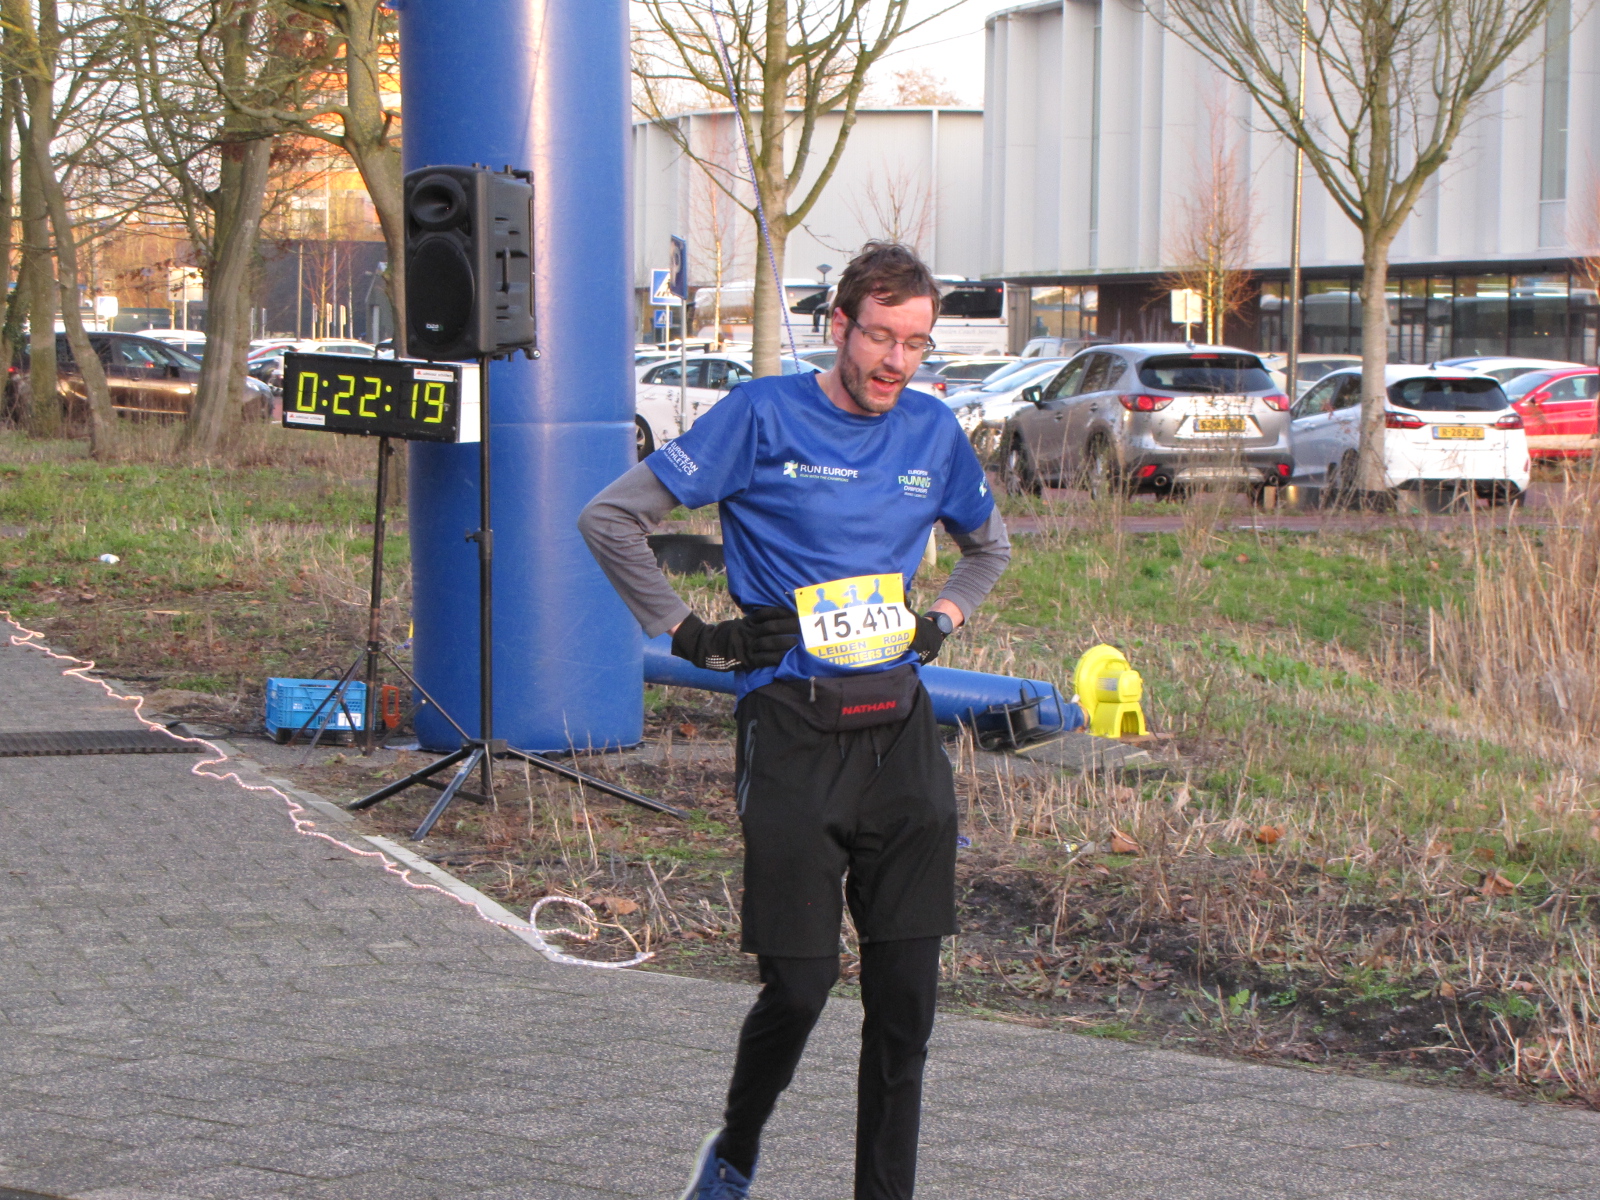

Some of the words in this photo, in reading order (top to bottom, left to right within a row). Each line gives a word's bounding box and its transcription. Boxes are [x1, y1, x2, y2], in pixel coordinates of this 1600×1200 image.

[296, 371, 446, 424] 0:22:19
[665, 446, 694, 476] ATHLETICS
[670, 441, 699, 473] EUROPEAN
[800, 464, 821, 474] RUN
[822, 466, 859, 479] EUROPE
[813, 605, 902, 642] 15.417
[818, 641, 867, 657] LEIDEN
[883, 632, 910, 645] ROAD
[828, 648, 882, 666] UNNERS
[884, 643, 909, 657] CLUB
[841, 700, 897, 715] NATHAN
